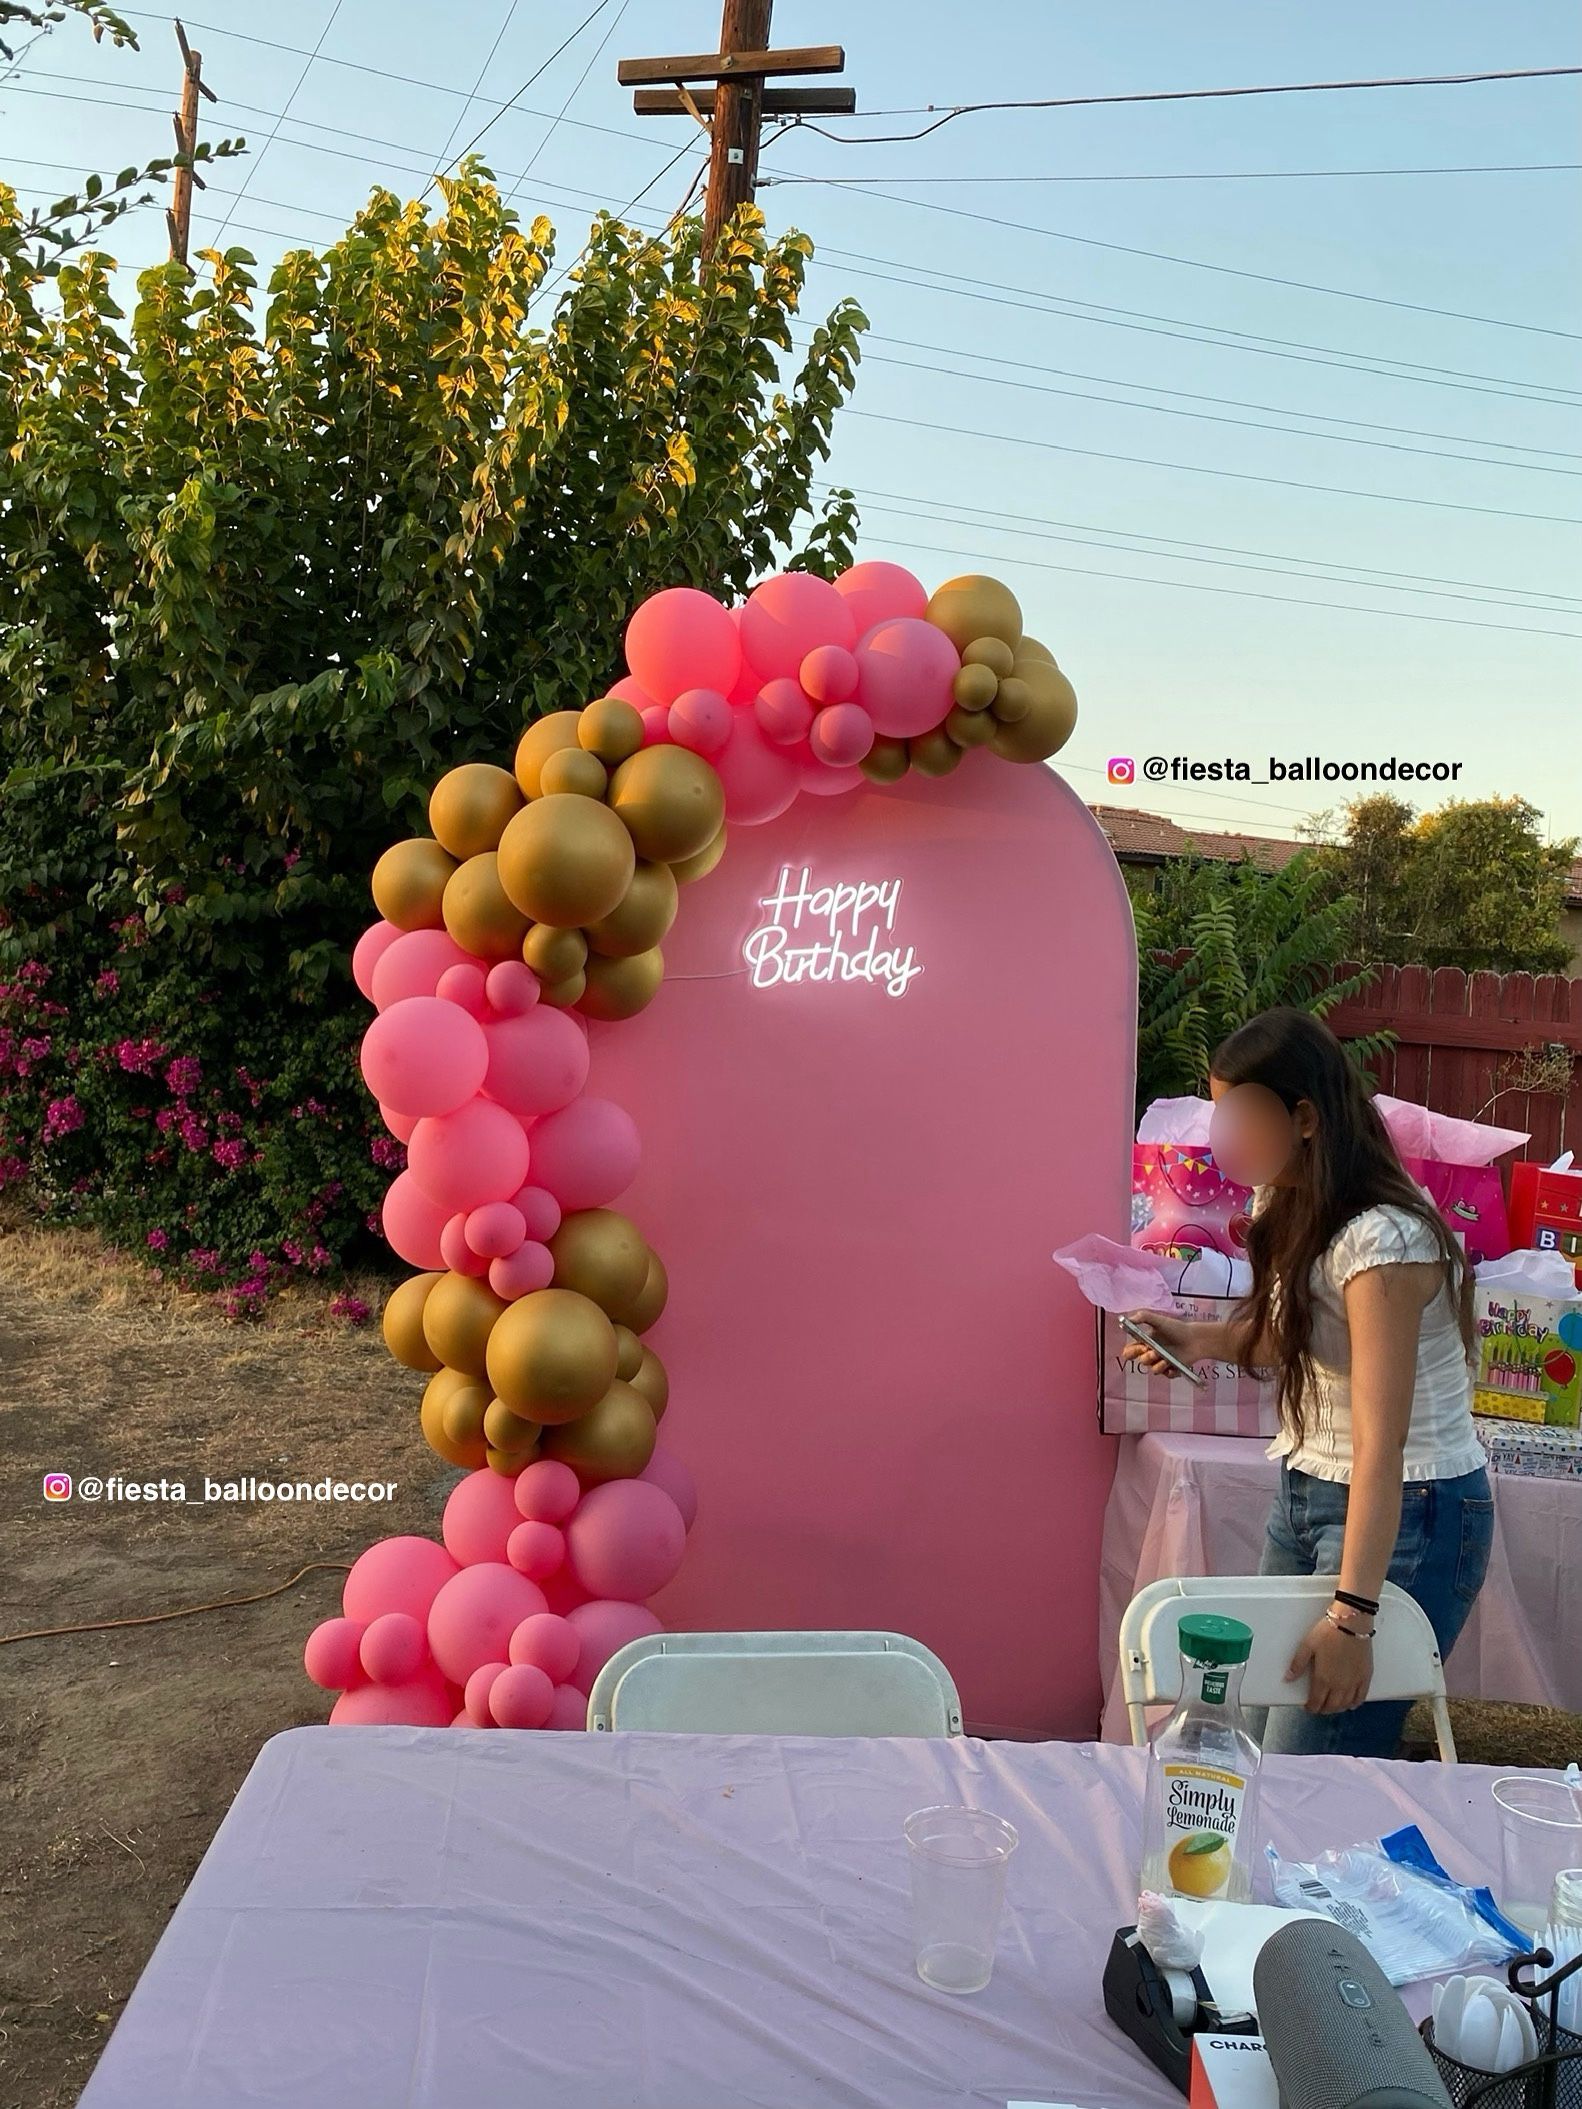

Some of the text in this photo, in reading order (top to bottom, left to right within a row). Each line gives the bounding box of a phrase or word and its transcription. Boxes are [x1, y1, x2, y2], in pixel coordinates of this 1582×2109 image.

[761, 866, 903, 938] Happy
[744, 925, 924, 998] Birthday
[1488, 1301, 1531, 1326] Happy
[1479, 1319, 1549, 1344] Birthday
[1115, 1356, 1220, 1380] VICA'S
[1195, 1771, 1230, 1783] NATURAL
[1168, 1779, 1237, 1820] Simply
[1166, 1806, 1236, 1834] Lemonade
[1209, 2040, 1267, 2052] CHAR
